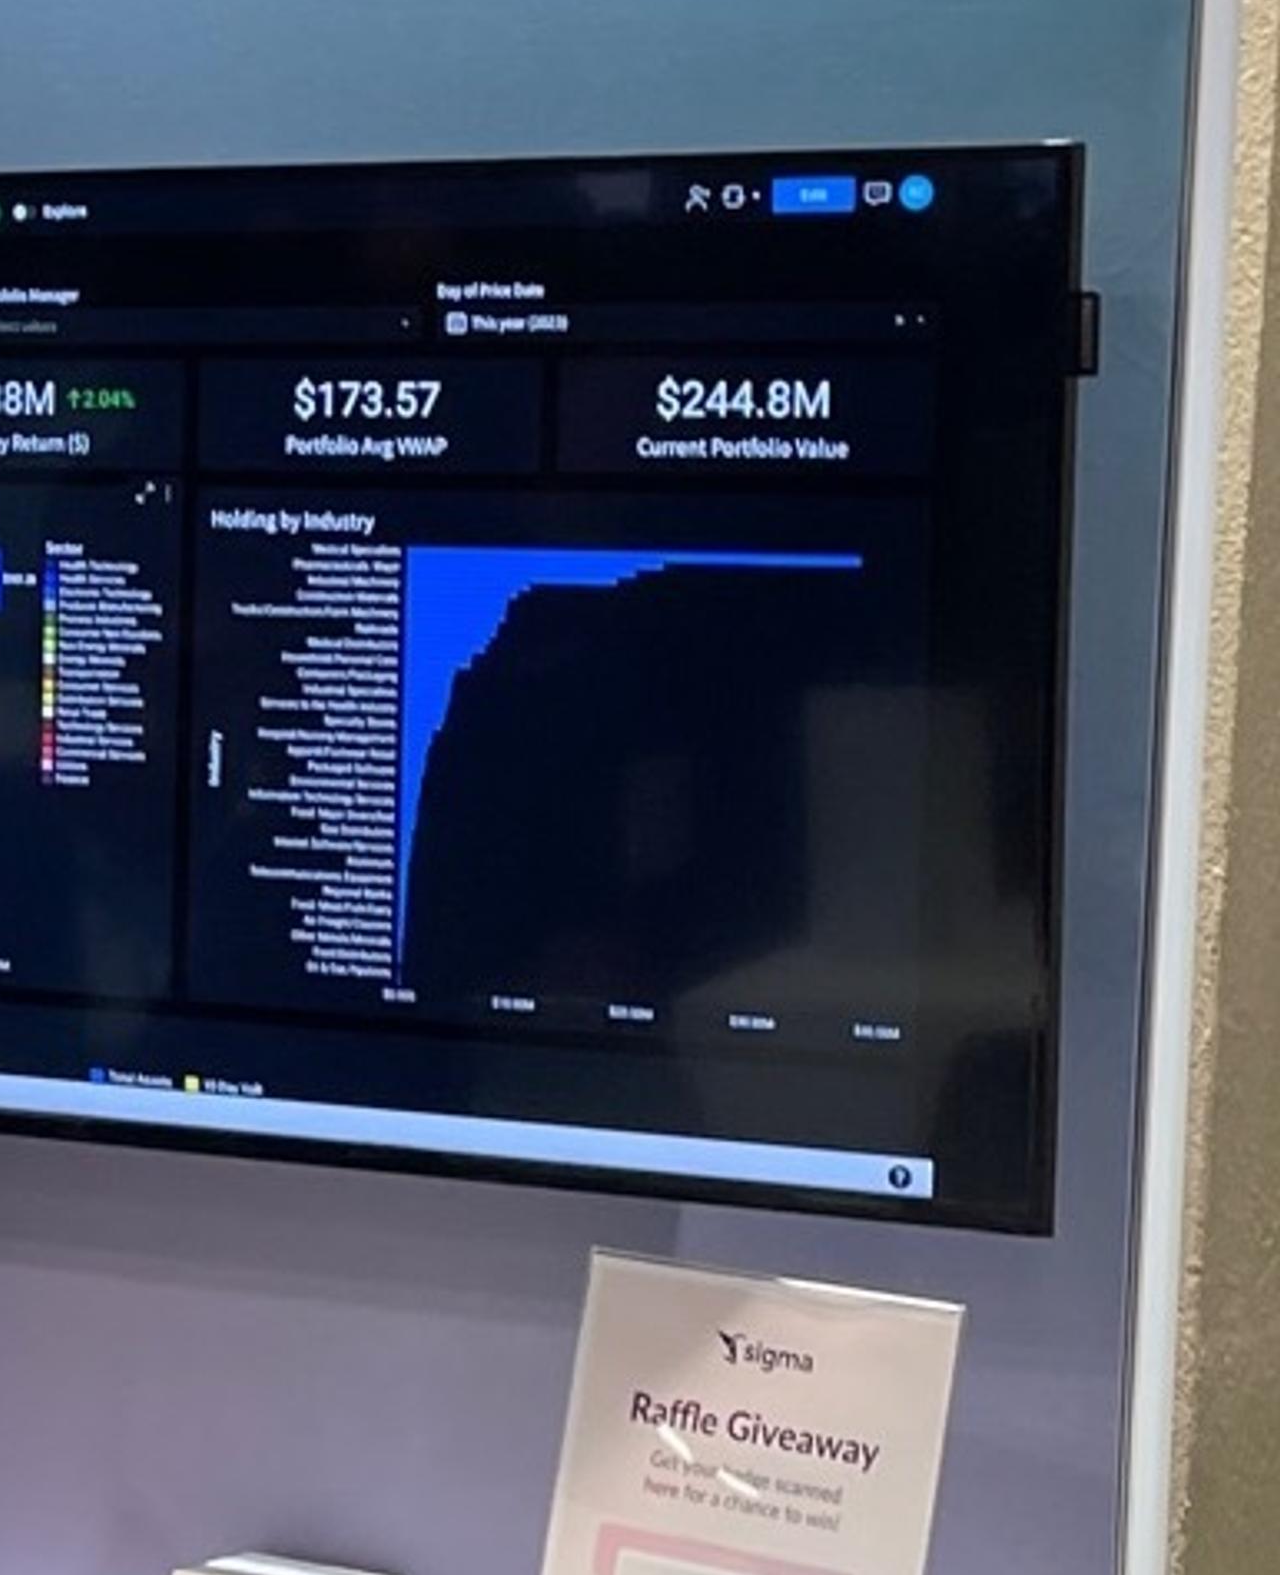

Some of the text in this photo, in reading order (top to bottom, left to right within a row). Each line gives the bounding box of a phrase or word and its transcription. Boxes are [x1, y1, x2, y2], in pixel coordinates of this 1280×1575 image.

[293, 376, 443, 423] $173.57
[655, 374, 833, 423] $244.8M
[11, 433, 66, 453] Return
[284, 434, 450, 462] Portfolio Avg VWAP
[636, 435, 851, 460] Current Portfolio Value
[210, 508, 377, 537] Holding by Industry
[743, 1341, 815, 1373] sigma
[629, 1390, 881, 1474] Raffle Giveaway
[643, 1477, 679, 1498] here
[683, 1485, 706, 1504] for
[709, 1494, 721, 1508] a
[784, 1505, 803, 1524] to
[775, 1477, 843, 1506] scanned
